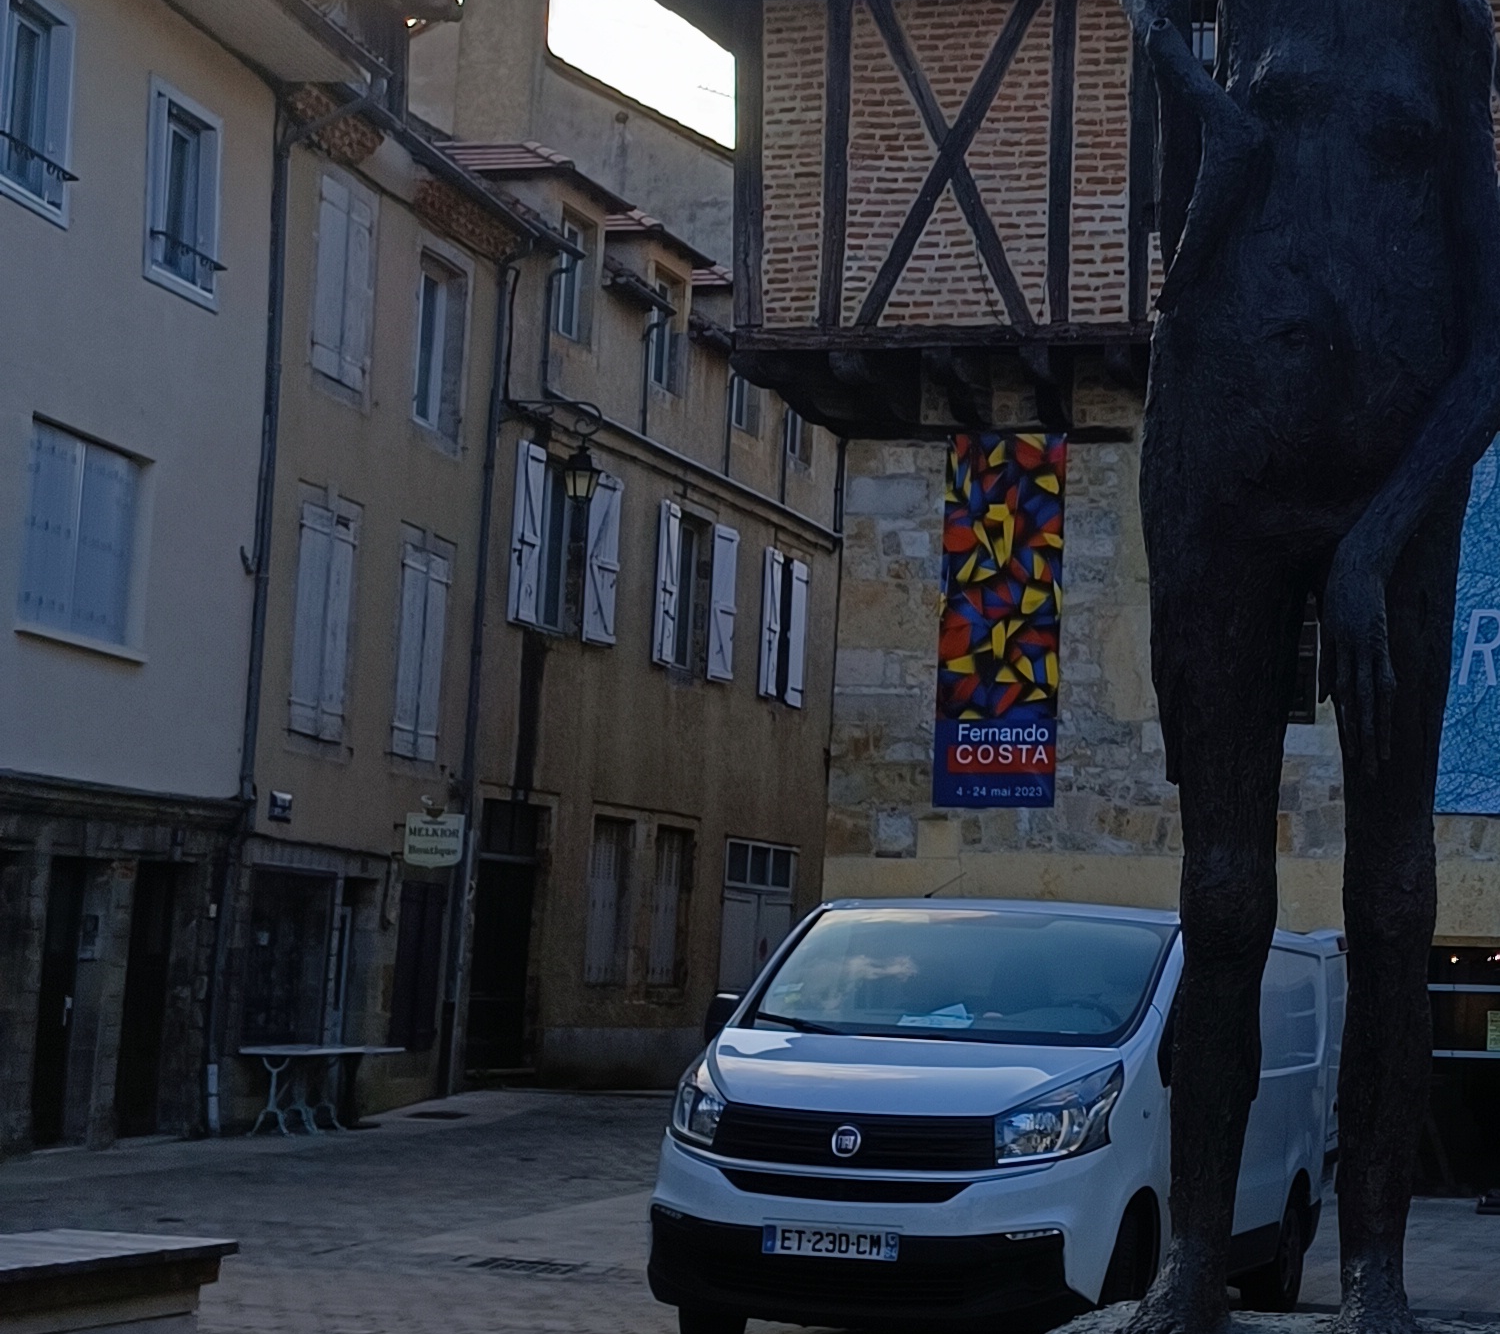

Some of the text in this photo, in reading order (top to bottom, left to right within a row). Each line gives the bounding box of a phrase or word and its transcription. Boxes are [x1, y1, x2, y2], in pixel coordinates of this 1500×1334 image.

[958, 723, 1049, 742] Fernando
[956, 744, 1049, 764] COSTA
[956, 786, 963, 797] 4
[973, 786, 987, 797] 24
[990, 786, 1011, 797] mai
[1014, 786, 1043, 797] 2023
[408, 826, 460, 839] MELKIOR
[408, 843, 458, 857] Boutique
[780, 1229, 882, 1256] ET-230-CM
